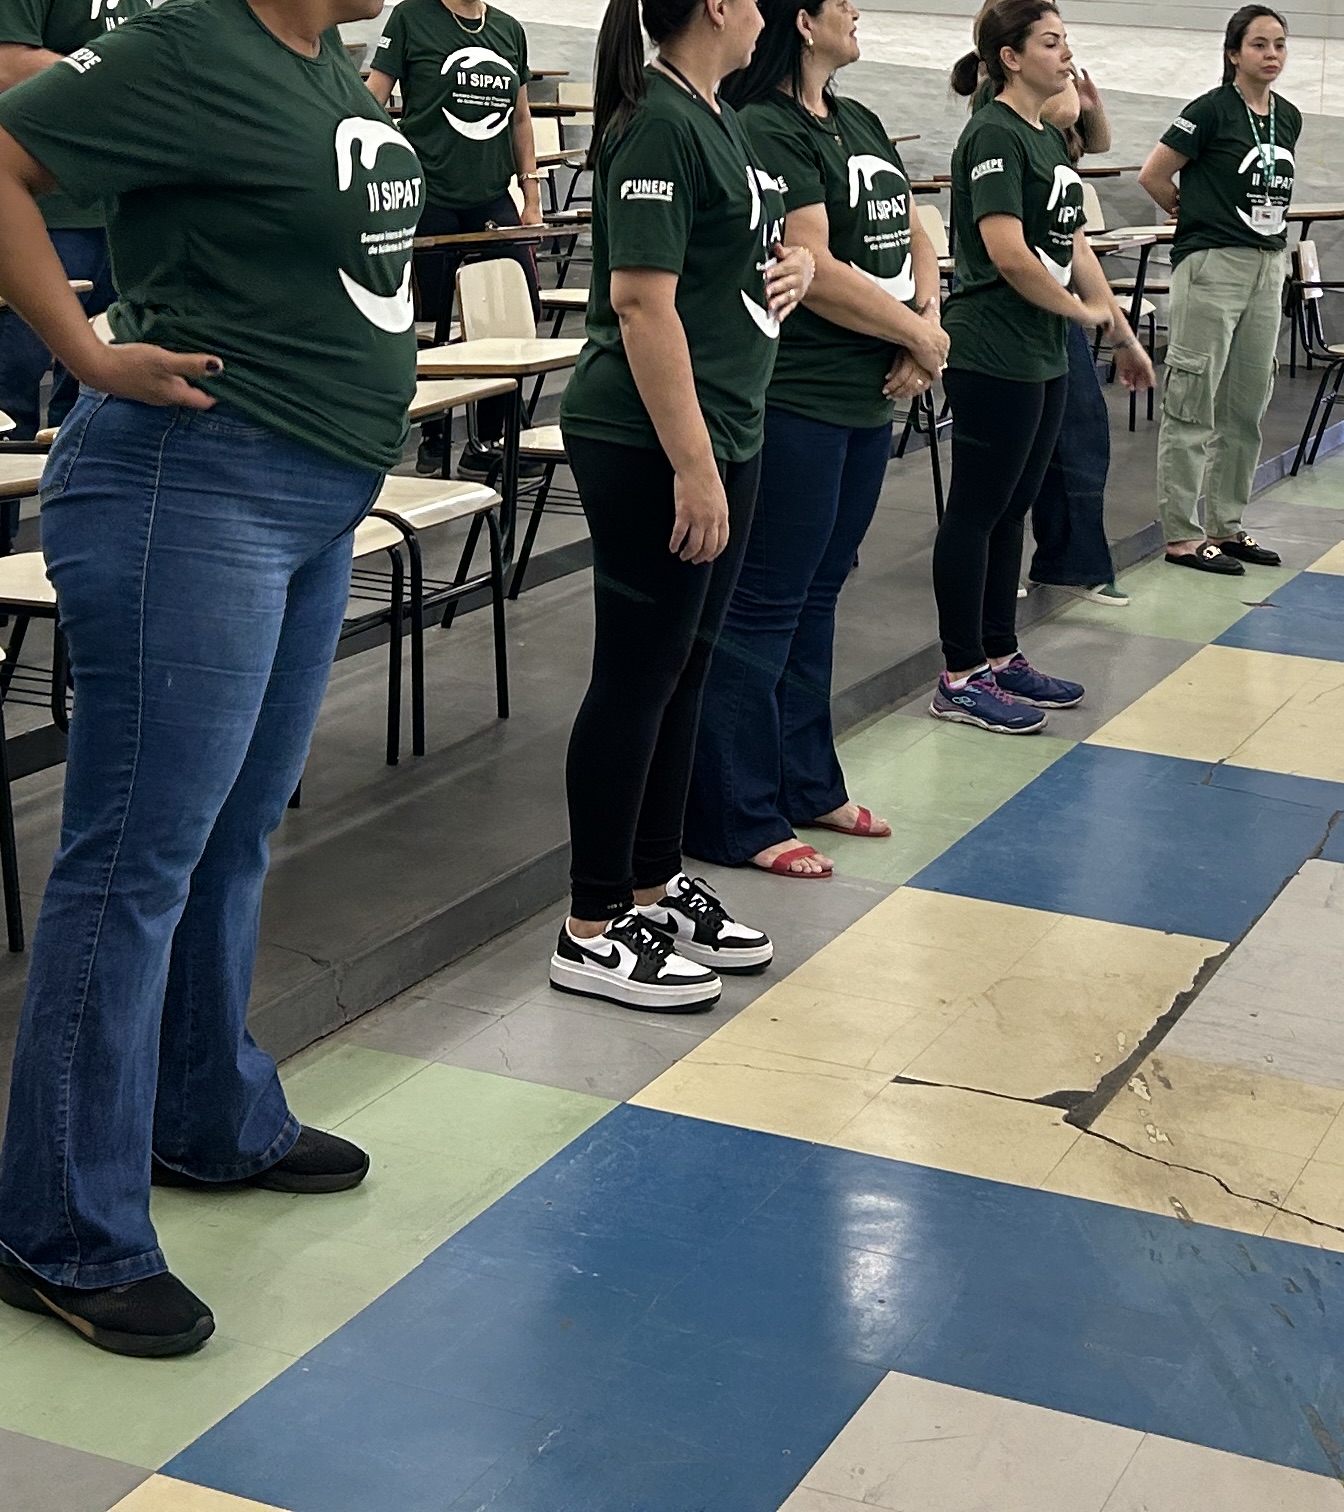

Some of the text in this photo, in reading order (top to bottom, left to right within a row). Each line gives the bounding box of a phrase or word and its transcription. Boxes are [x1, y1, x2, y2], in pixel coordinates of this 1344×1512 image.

[457, 71, 512, 90] II SIPAT
[620, 179, 674, 200] FUNEPE
[1263, 175, 1294, 190] IPAT
[367, 178, 422, 212] II SIPAT
